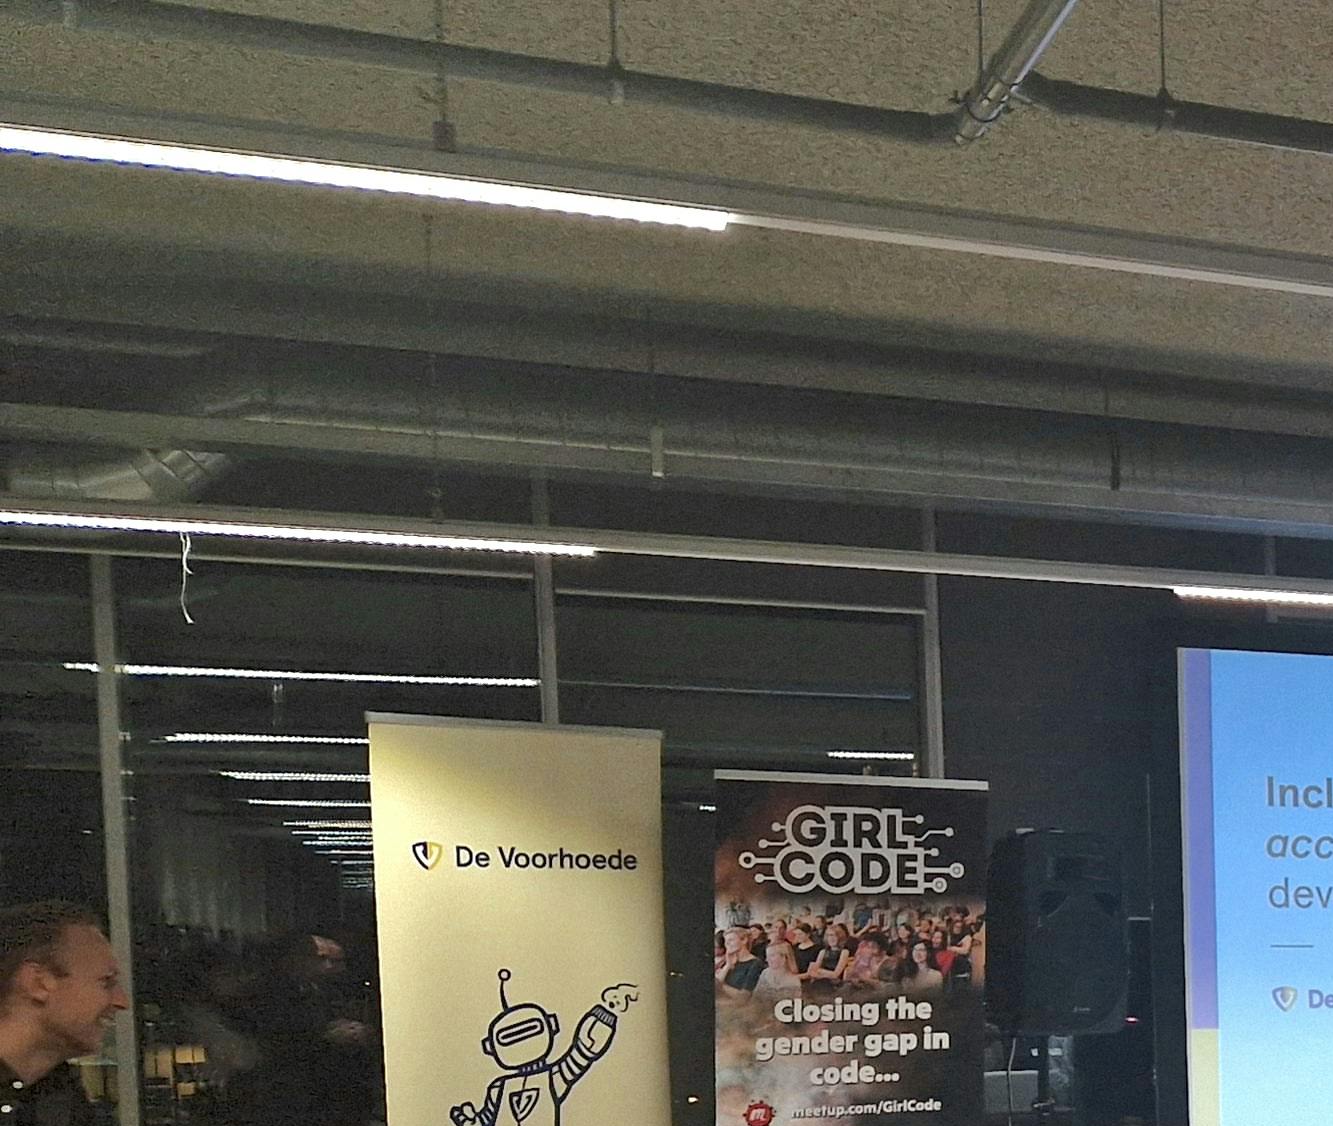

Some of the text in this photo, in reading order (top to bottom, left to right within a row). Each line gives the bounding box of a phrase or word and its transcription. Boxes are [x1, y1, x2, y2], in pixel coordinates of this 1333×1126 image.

[789, 810, 909, 849] GIRL
[456, 845, 637, 871] De Voorhoede
[779, 850, 921, 889] CODE
[774, 996, 933, 1026] Closing the
[755, 1026, 951, 1062] gender gap in
[810, 1059, 900, 1086] code...
[791, 1098, 942, 1120] meetup.com/GirlCode
